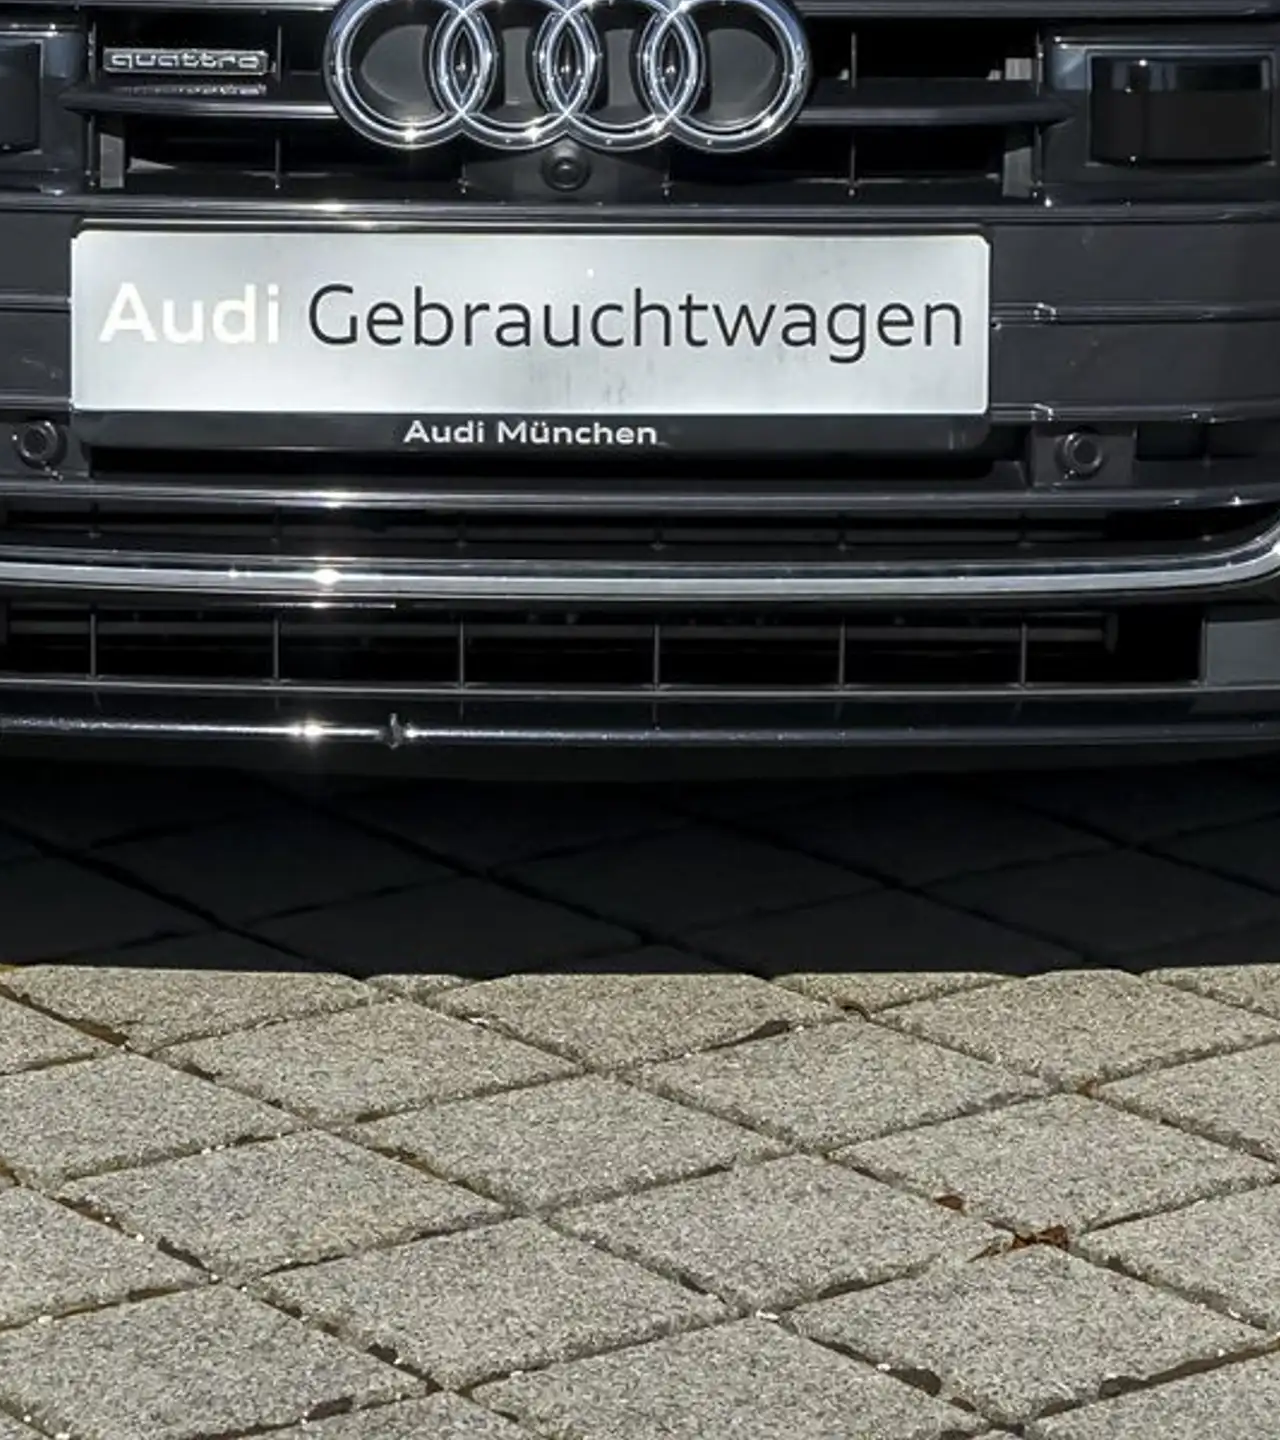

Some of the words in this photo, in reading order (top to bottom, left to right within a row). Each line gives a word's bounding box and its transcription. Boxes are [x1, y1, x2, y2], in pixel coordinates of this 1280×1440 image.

[110, 51, 261, 70] quattro
[98, 282, 280, 344] Audi
[308, 283, 962, 364] Gebrauchtwagen
[402, 419, 485, 444] Audi
[496, 419, 658, 445] München
